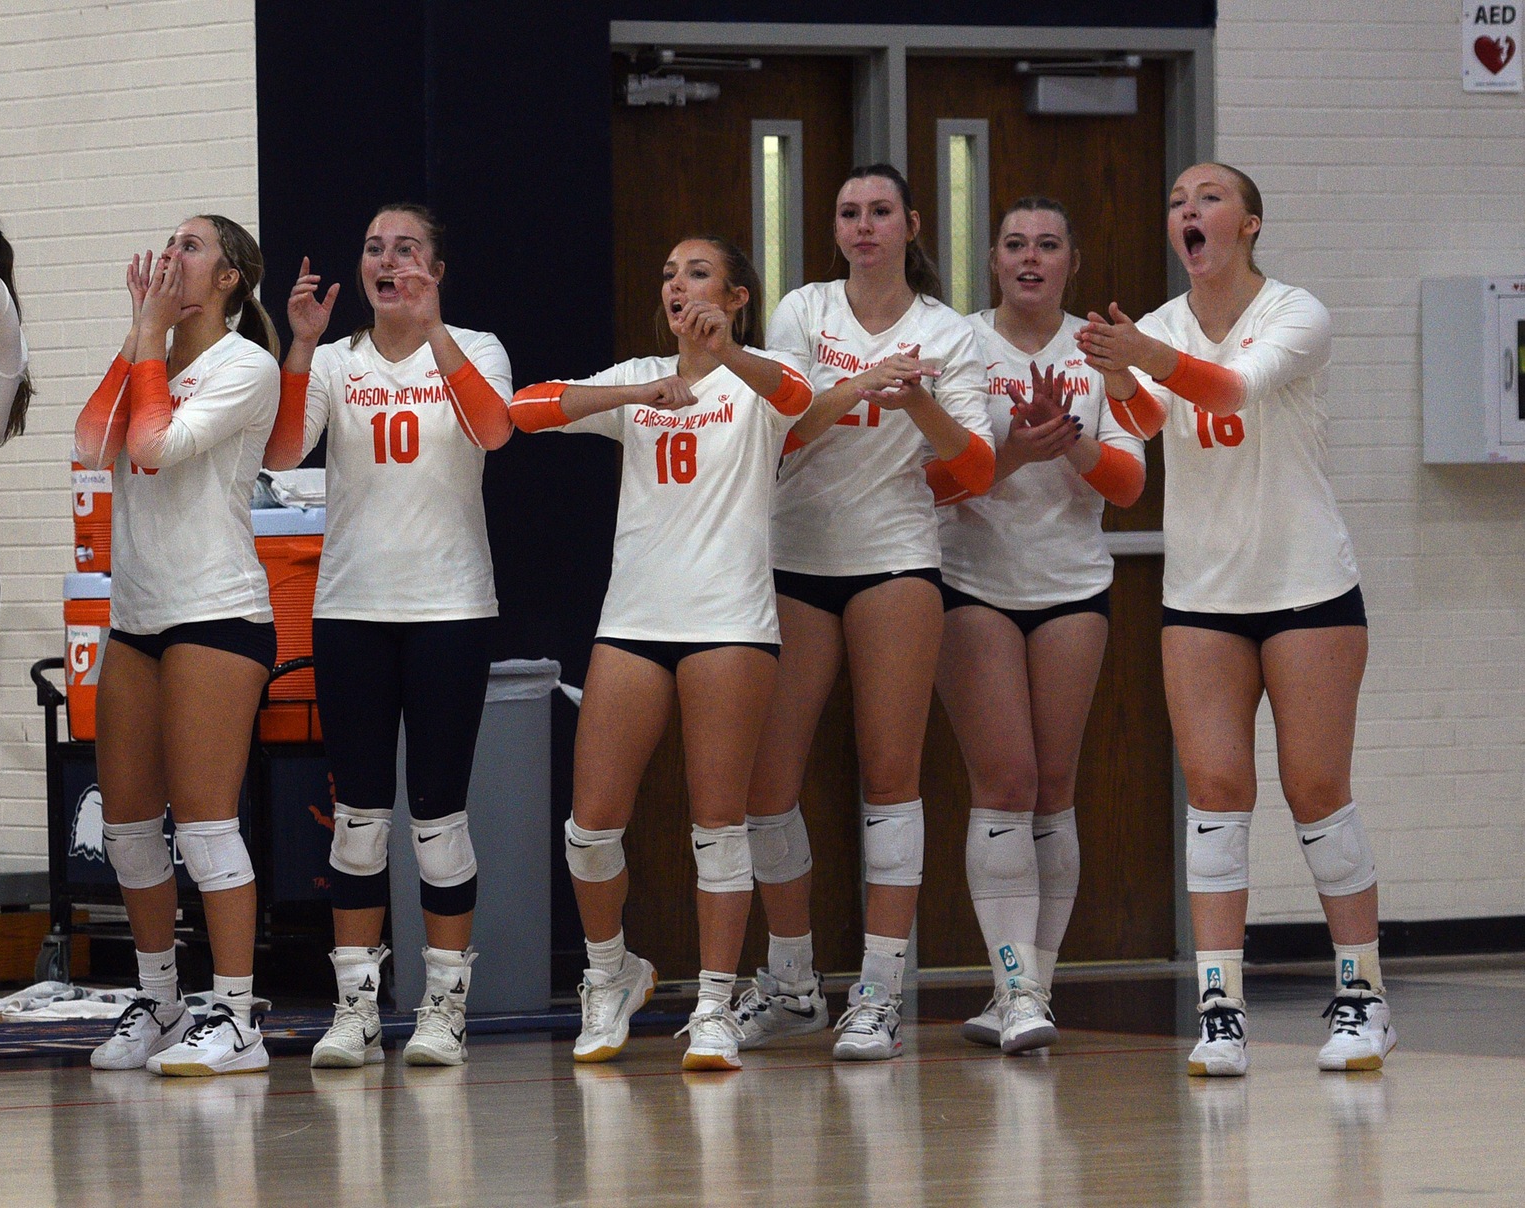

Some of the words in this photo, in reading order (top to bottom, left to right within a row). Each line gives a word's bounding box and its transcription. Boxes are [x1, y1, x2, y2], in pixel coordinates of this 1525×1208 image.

[1474, 6, 1516, 25] AED
[370, 411, 420, 465] 10
[655, 431, 698, 484] 18
[70, 637, 90, 673] G
